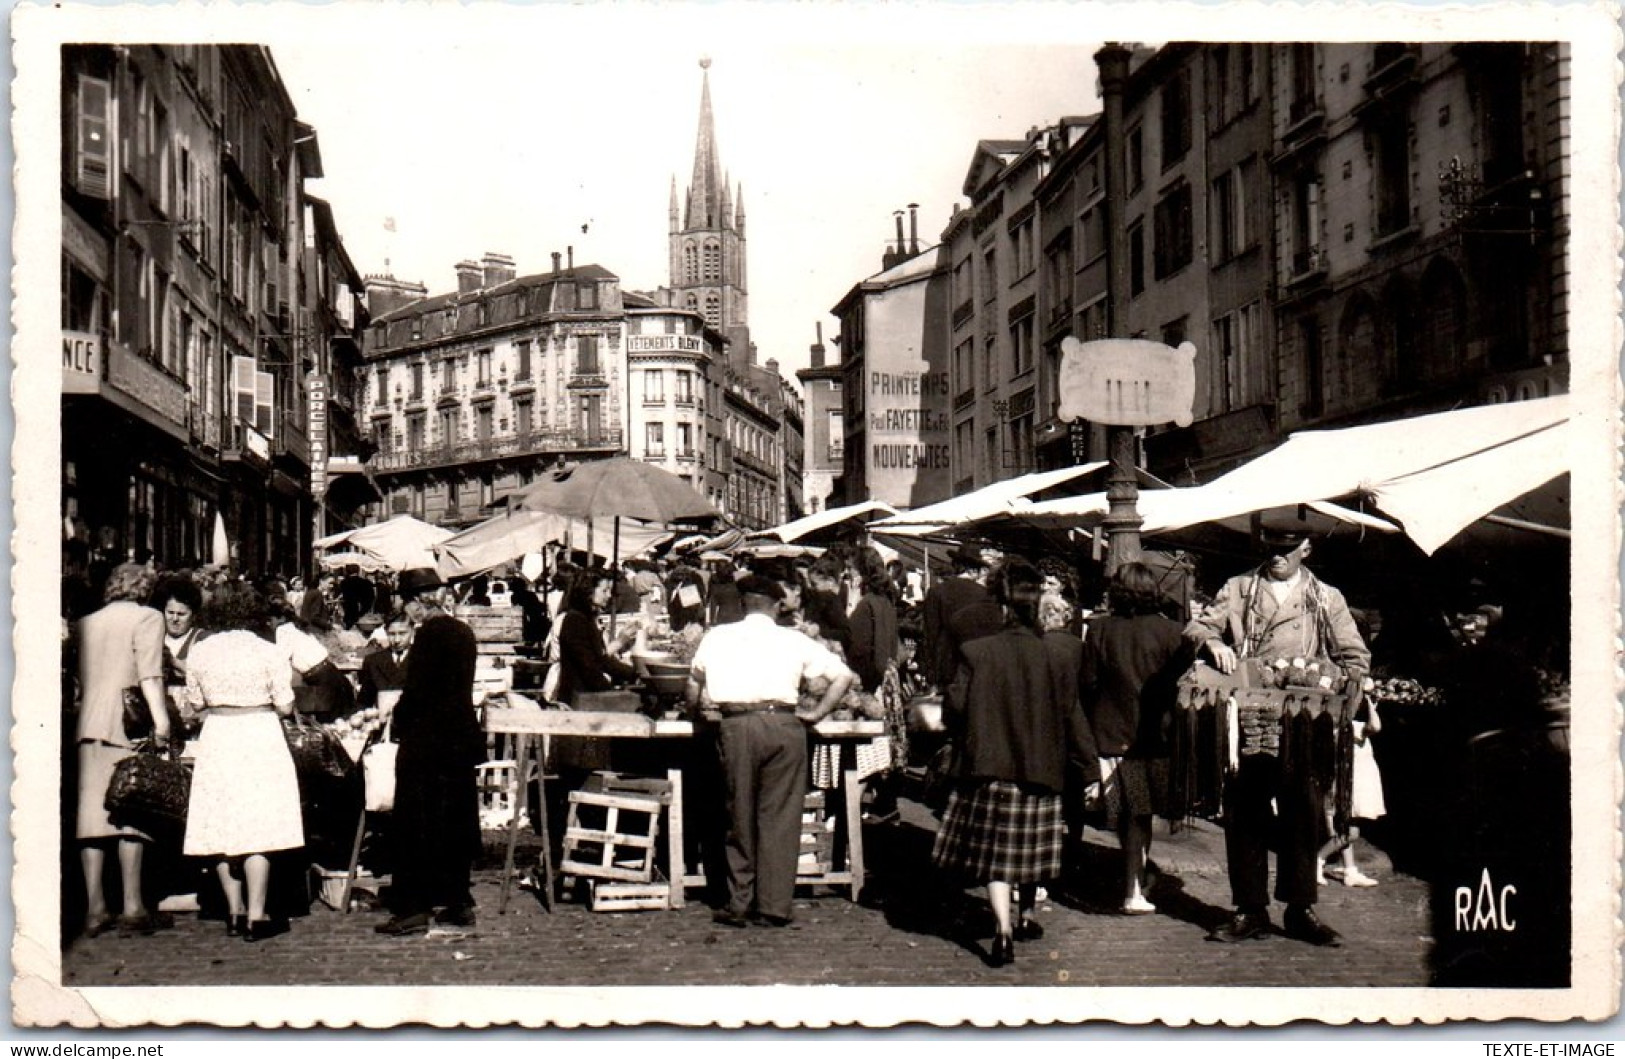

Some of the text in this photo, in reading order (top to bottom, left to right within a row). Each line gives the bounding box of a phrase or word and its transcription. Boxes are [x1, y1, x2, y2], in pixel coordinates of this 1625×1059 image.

[62, 338, 94, 374] NCE
[871, 371, 950, 396] PRINTEMPS
[886, 408, 932, 431] FAYETTE
[310, 381, 325, 494] PORCELAINES
